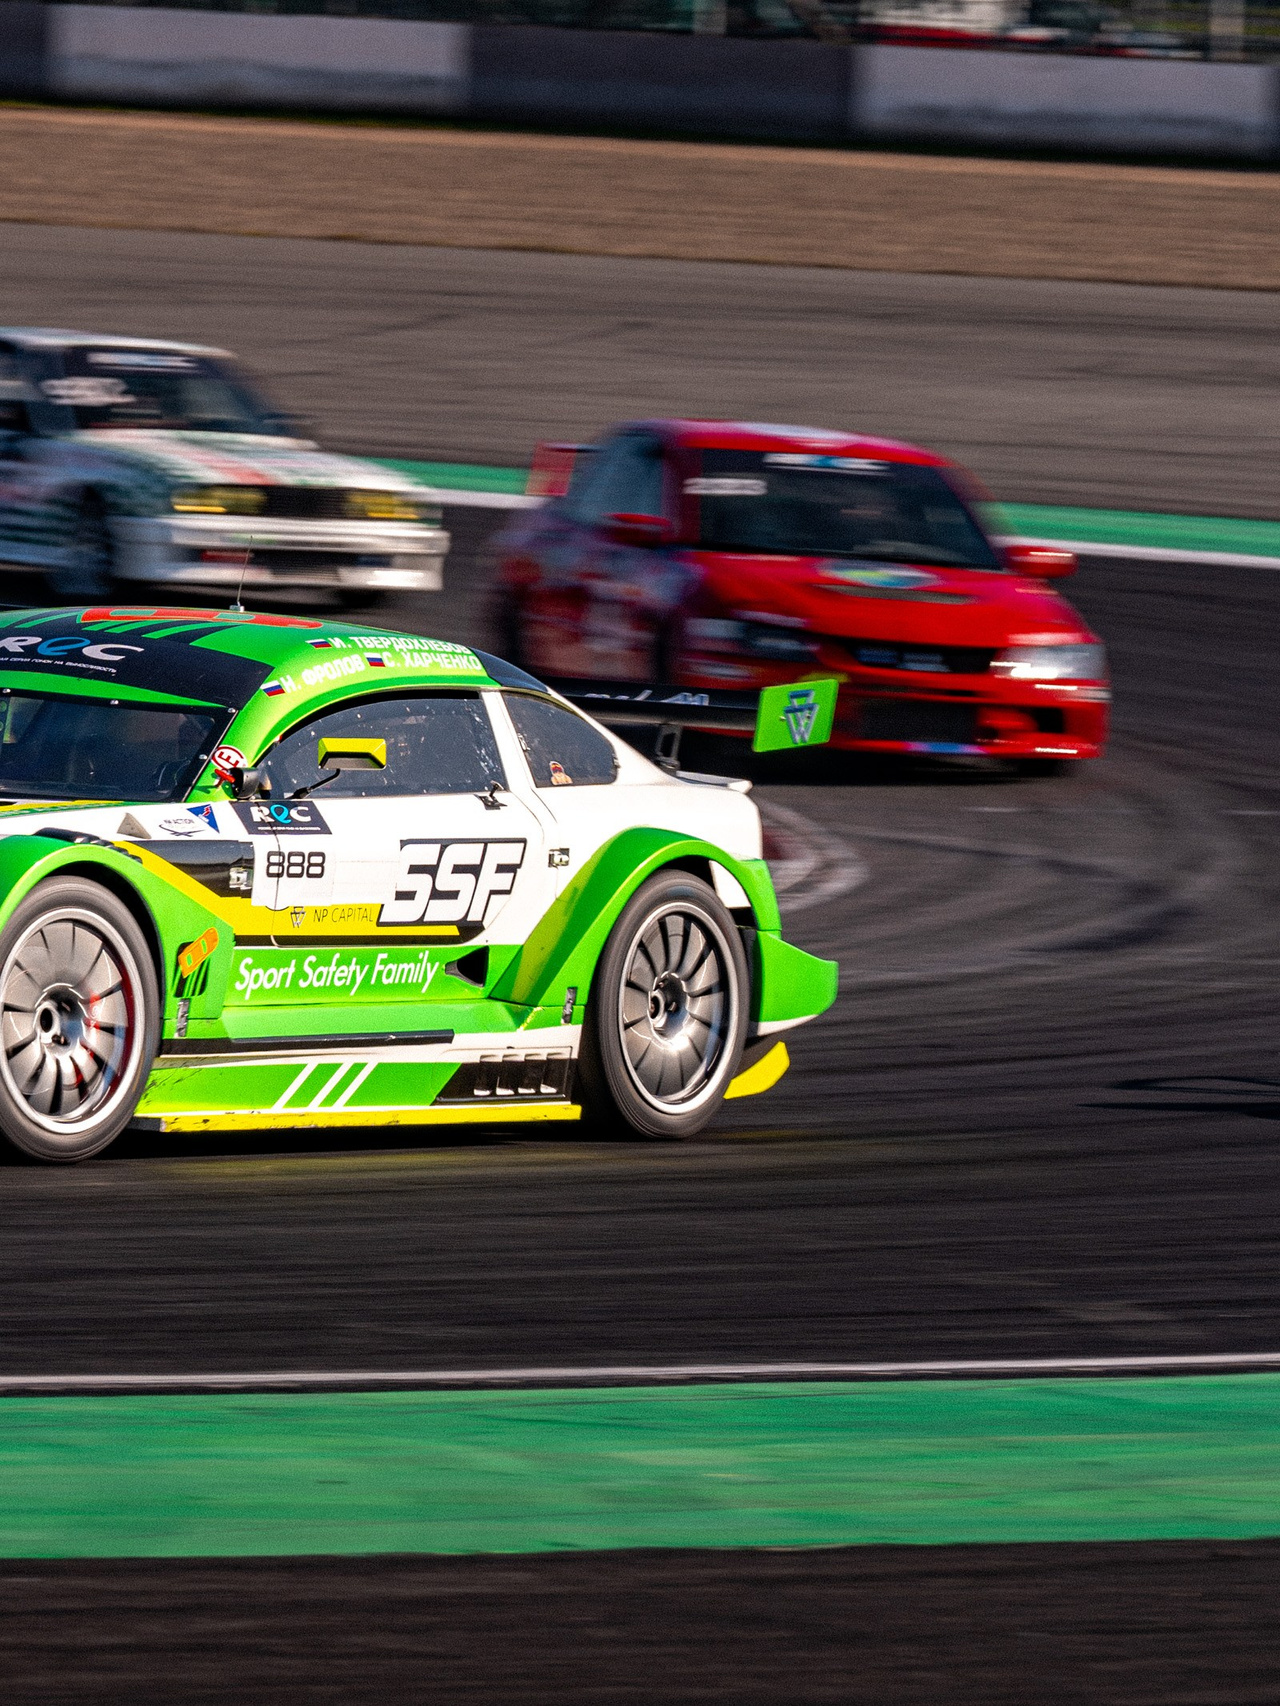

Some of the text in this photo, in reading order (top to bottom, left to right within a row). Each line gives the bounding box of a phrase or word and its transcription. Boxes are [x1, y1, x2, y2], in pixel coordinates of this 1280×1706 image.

[328, 636, 472, 654] И. ТВЕРДОХЛЕБОВ
[279, 654, 365, 693] Н. ФРОЛОВ
[385, 652, 483, 671] С. ХАРЧЕНКО
[266, 851, 326, 878] 888
[377, 838, 527, 928] SSF
[313, 906, 374, 923] NP CAPITAL
[235, 950, 440, 1000] Sport Safety Family
